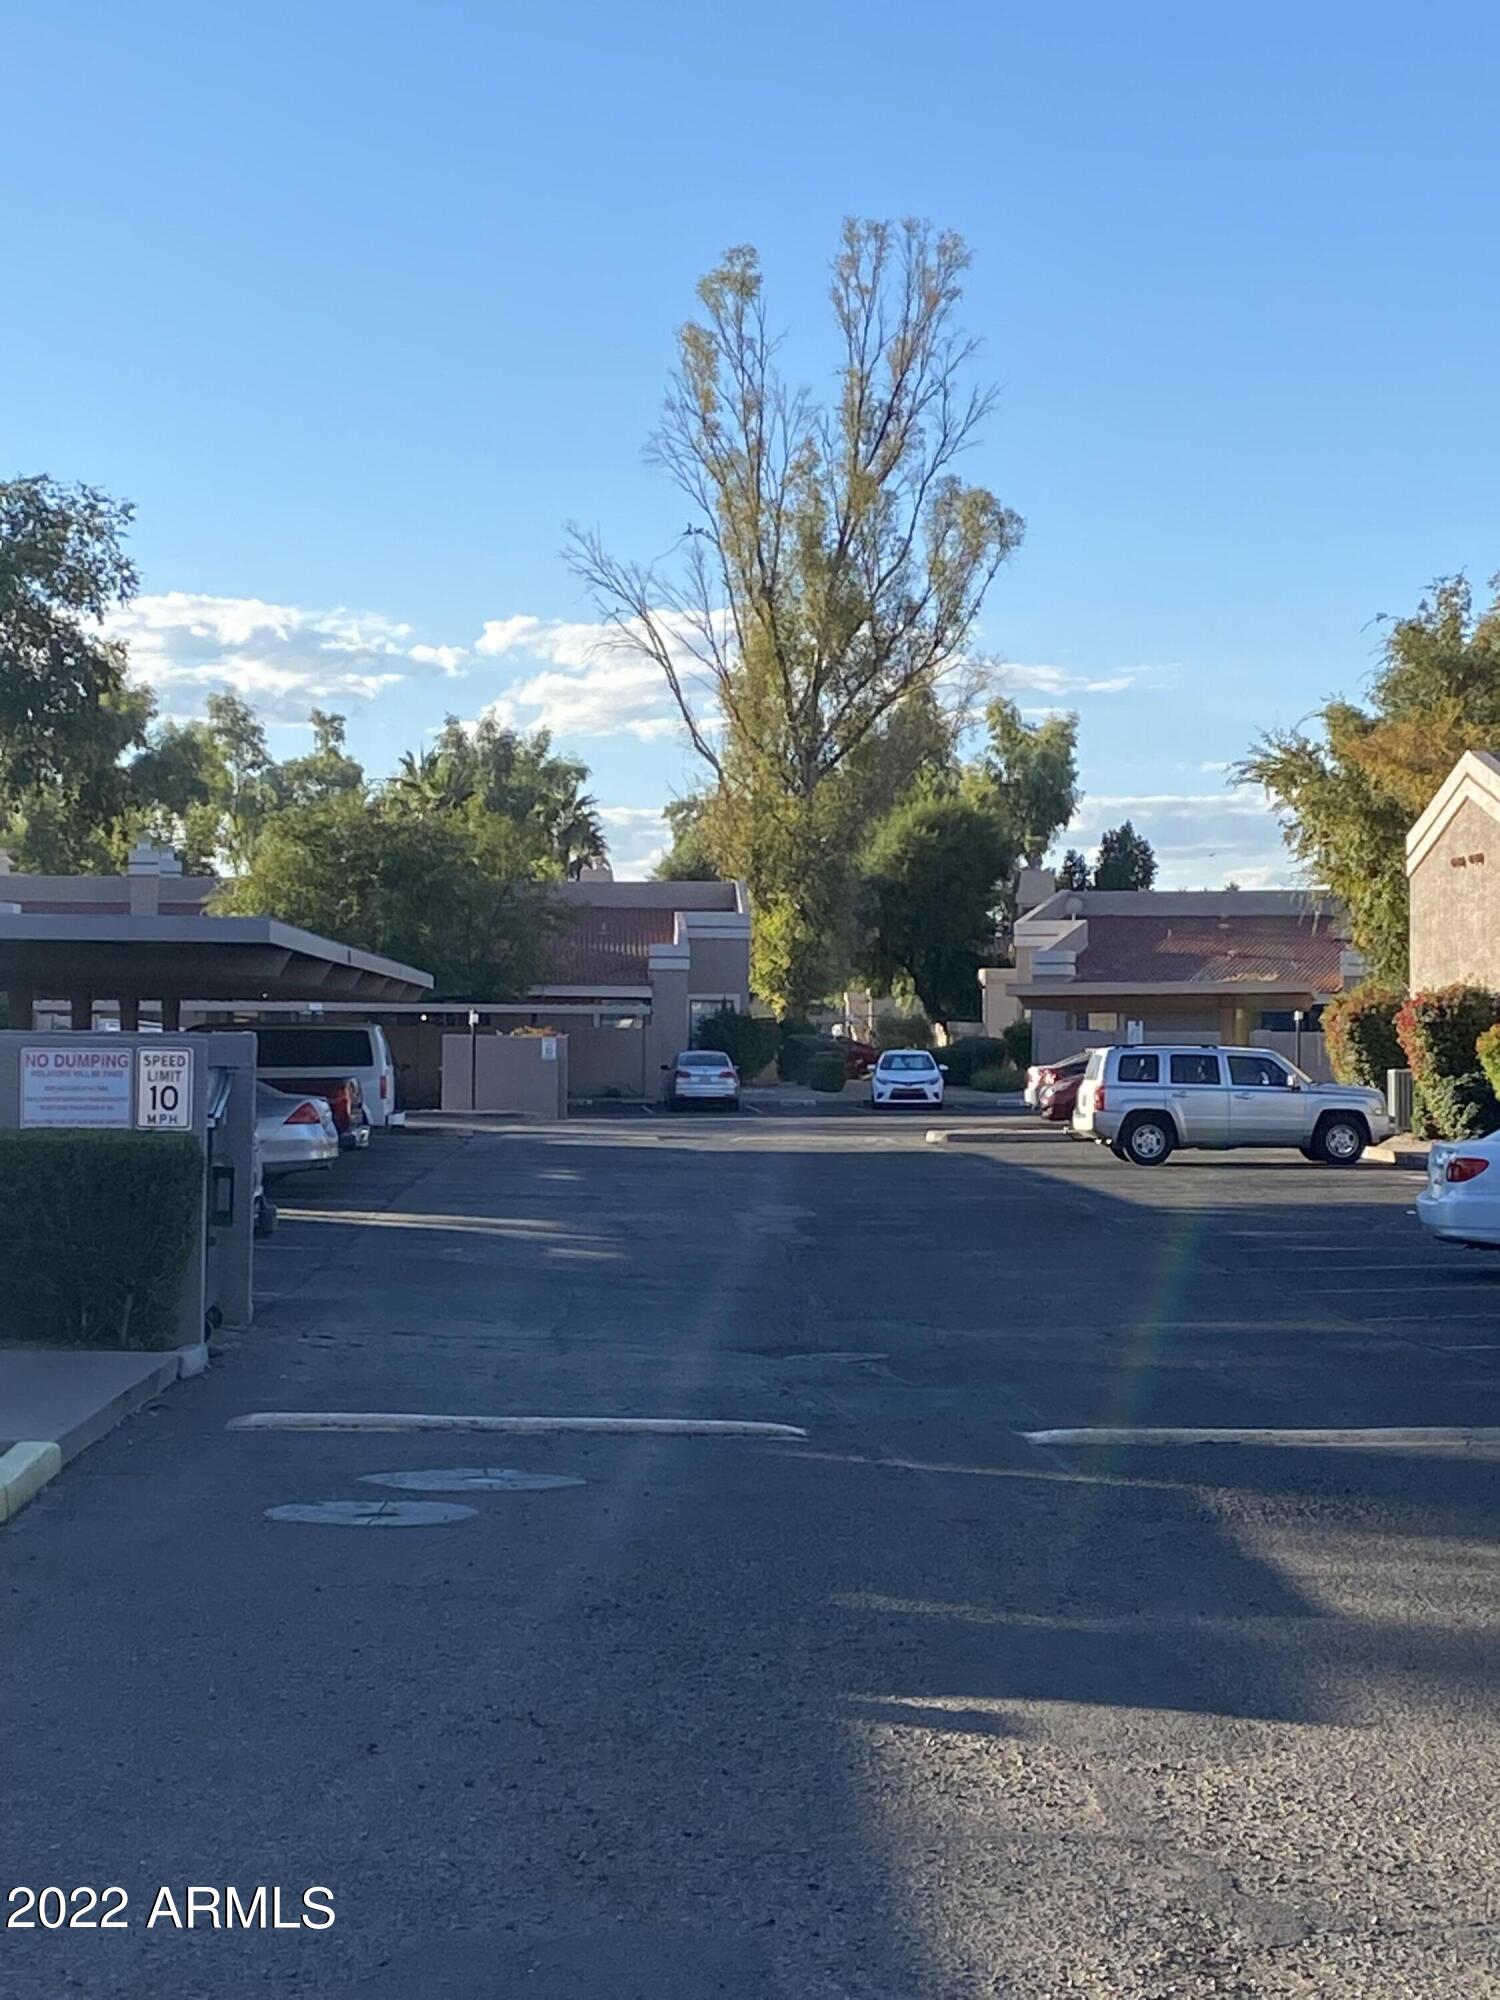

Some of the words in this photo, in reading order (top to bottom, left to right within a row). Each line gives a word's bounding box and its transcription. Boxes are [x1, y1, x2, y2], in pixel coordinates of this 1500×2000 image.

[25, 1054, 49, 1068] NO
[54, 1054, 128, 1068] DUMPING
[143, 1055, 186, 1067] SPEED
[147, 1070, 182, 1082] LIMIT
[150, 1085, 178, 1111] 10
[147, 1114, 178, 1124] MPH
